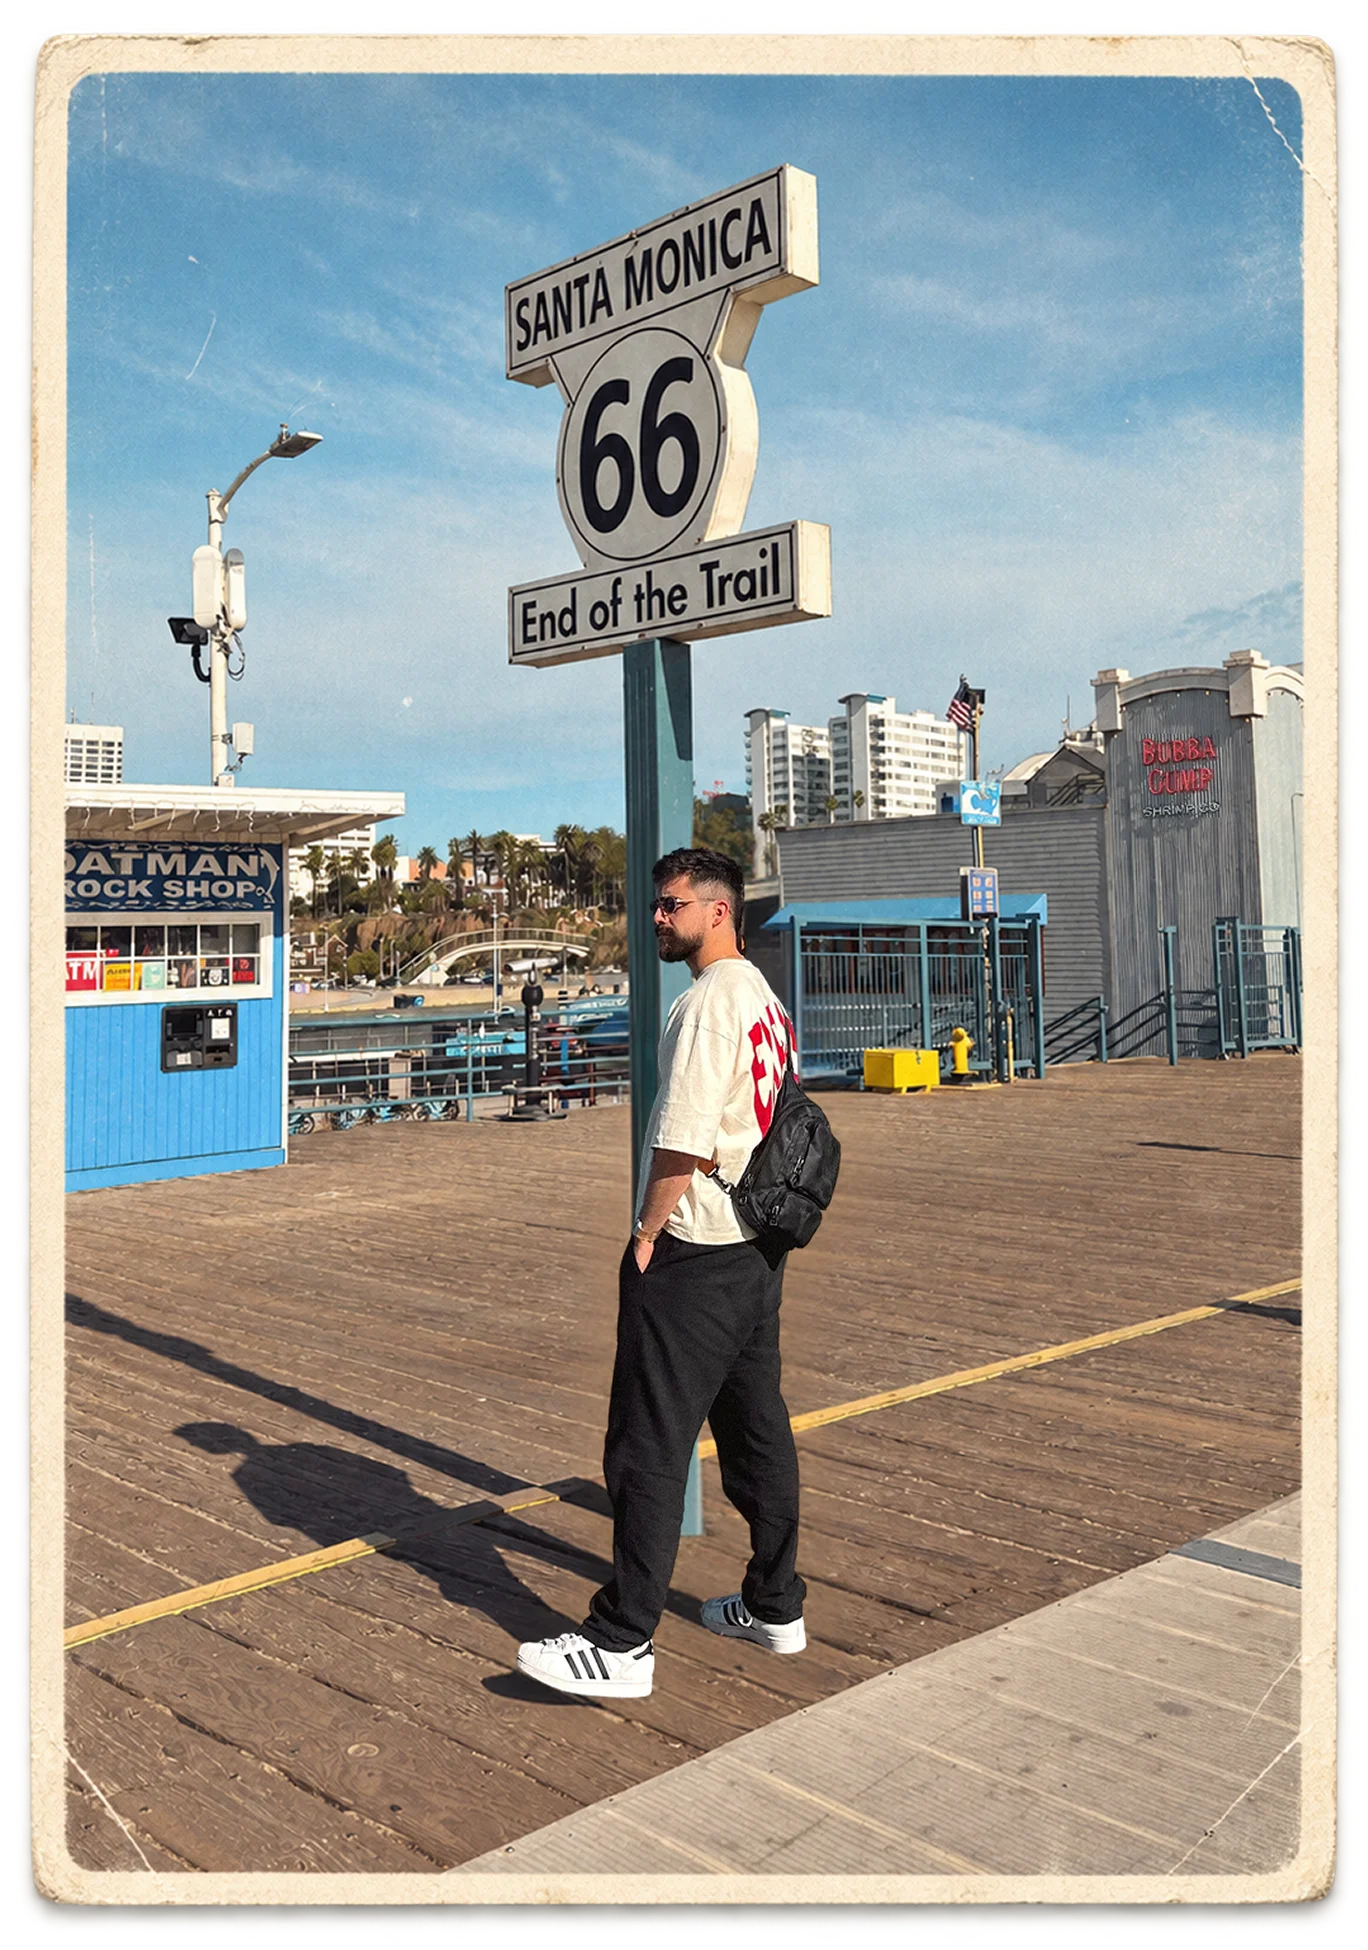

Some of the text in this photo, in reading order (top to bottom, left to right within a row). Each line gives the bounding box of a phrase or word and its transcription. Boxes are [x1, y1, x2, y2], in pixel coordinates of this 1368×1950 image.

[516, 197, 772, 351] SANTA MONICA
[580, 356, 700, 533] 66
[522, 542, 780, 645] End of the Trail
[1142, 736, 1216, 765] BUBBA
[1148, 768, 1212, 795] GUMP
[163, 880, 256, 898] SHOP
